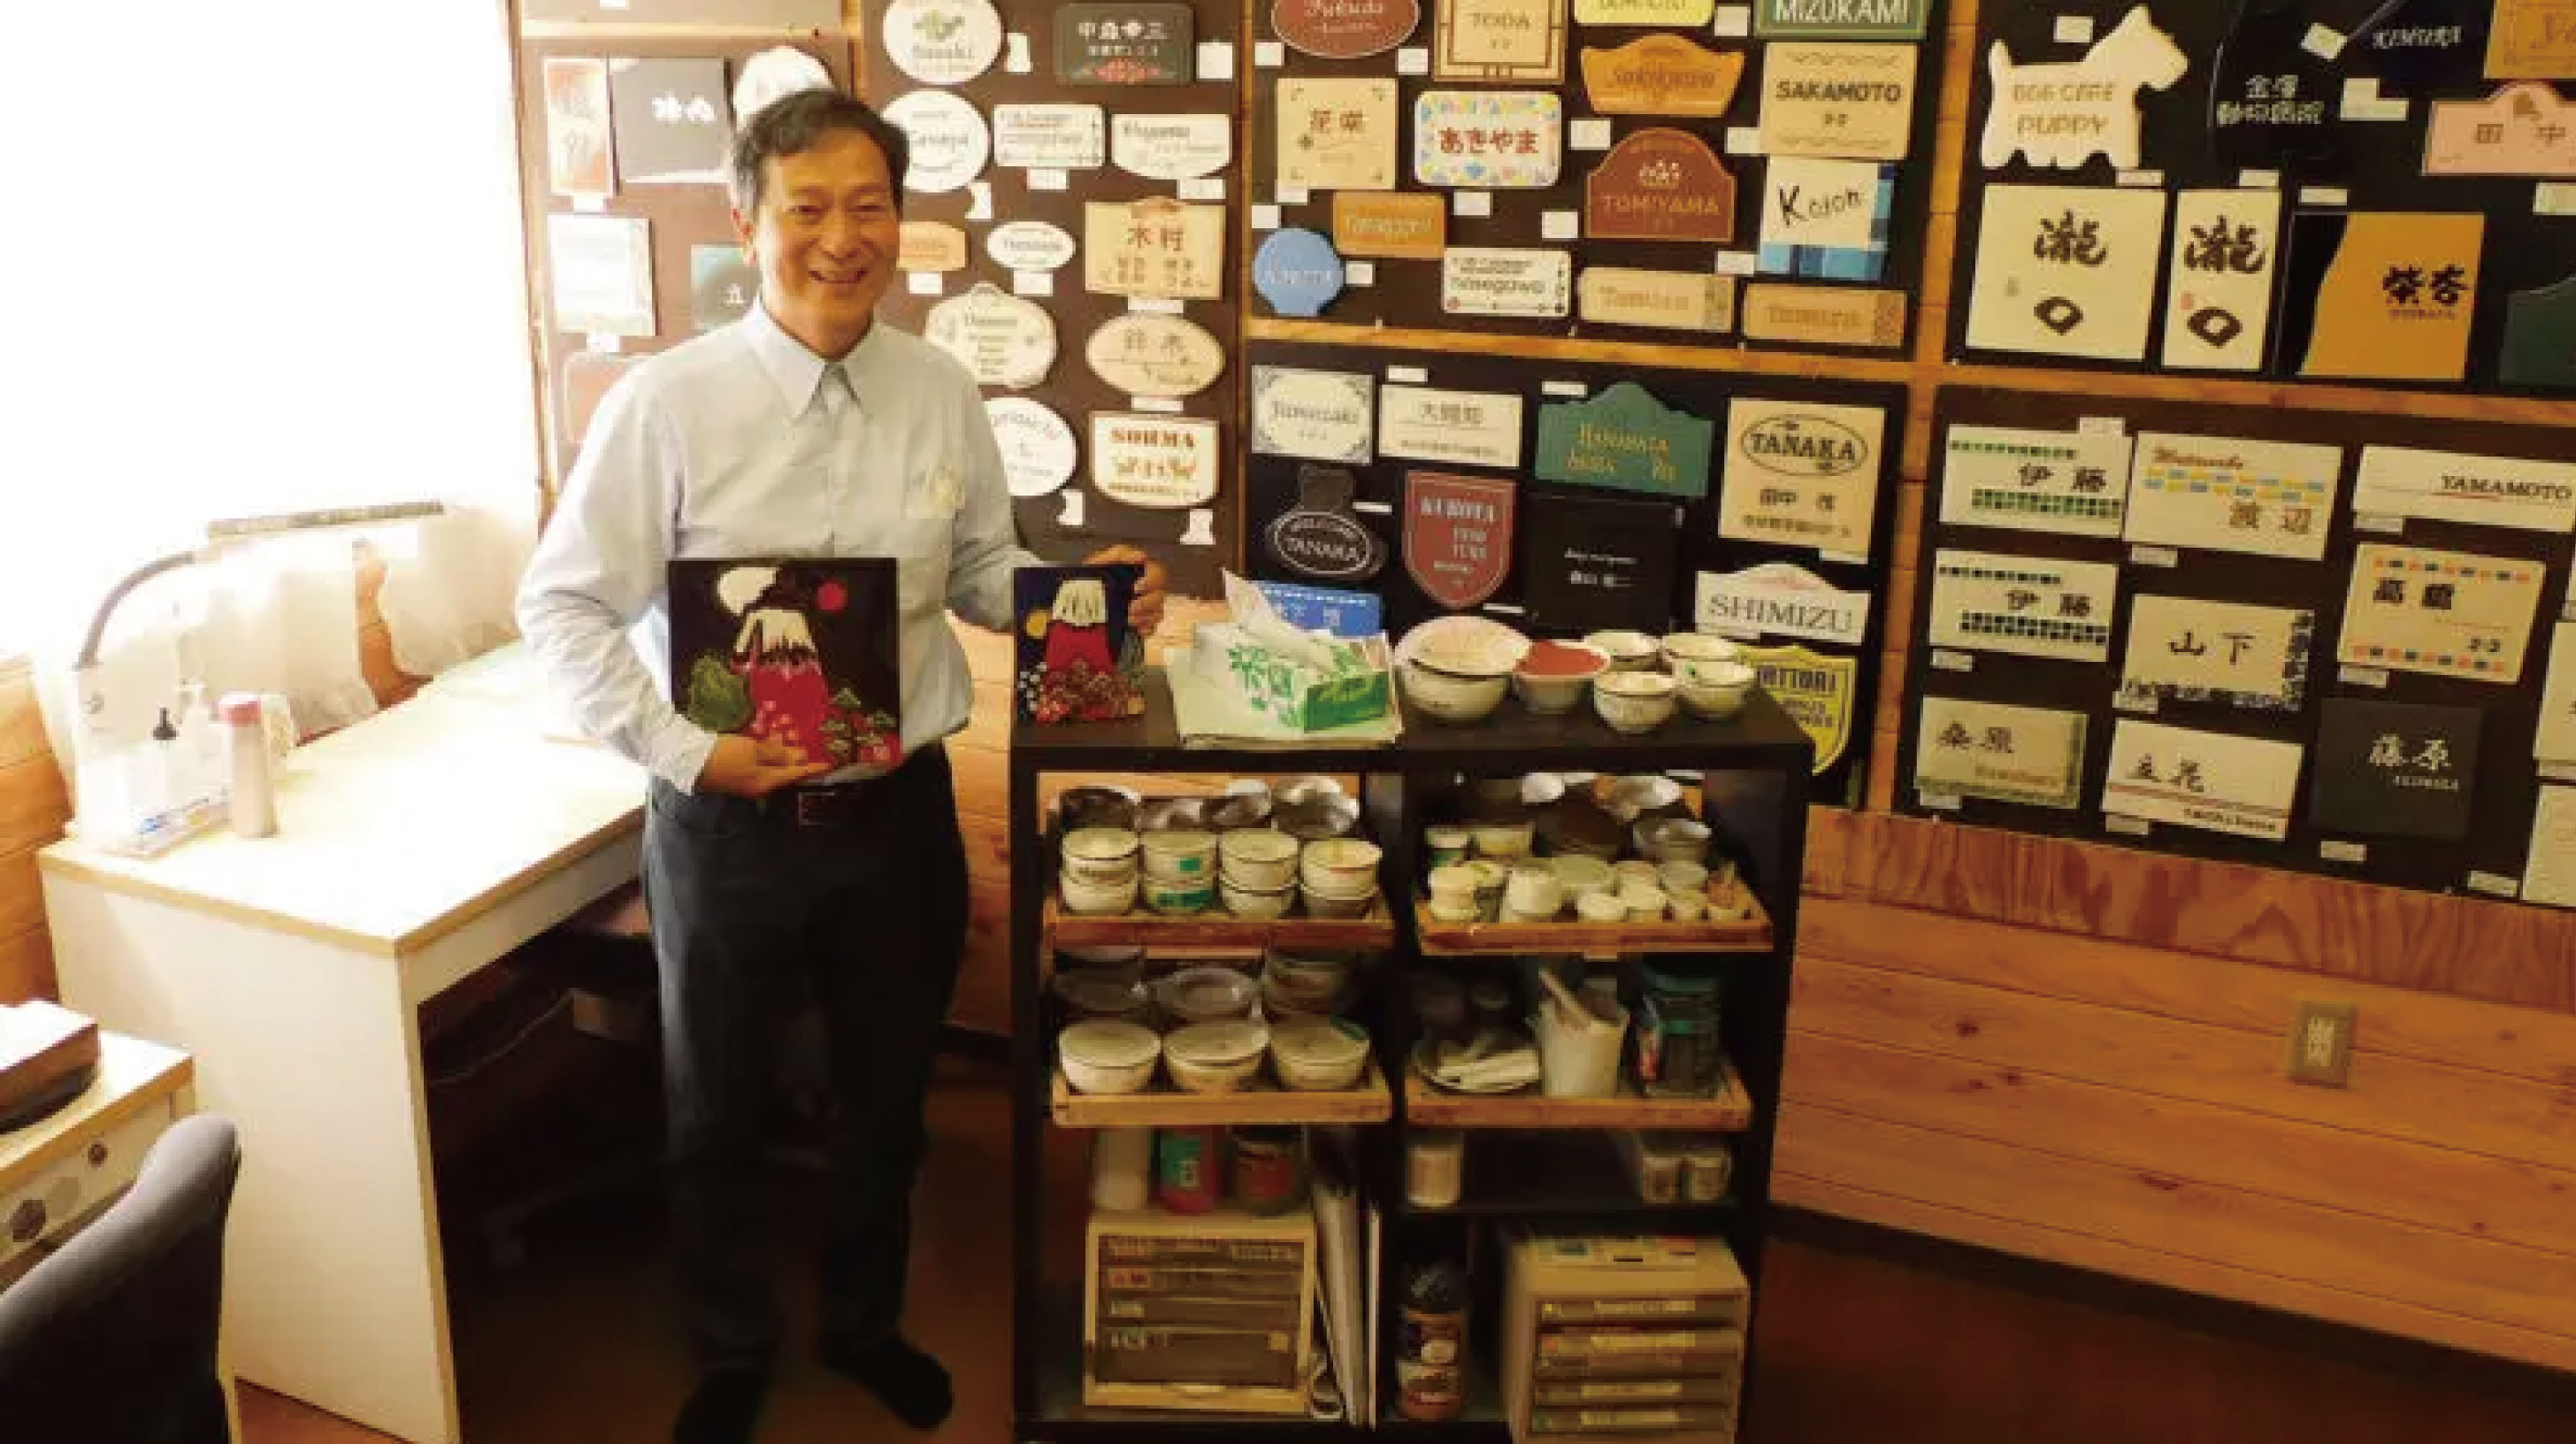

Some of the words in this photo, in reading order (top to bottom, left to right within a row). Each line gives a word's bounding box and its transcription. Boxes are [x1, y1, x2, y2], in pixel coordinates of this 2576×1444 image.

[1775, 81, 1902, 103] SAKAMOTO
[2017, 113, 2110, 135] PUPPY
[2473, 123, 2566, 145] 田中
[1438, 127, 1539, 154] あきやま
[1600, 194, 1721, 214] TOMIYAMA
[1126, 225, 1184, 252] 木村
[1750, 432, 1856, 462] TANAKA
[2440, 473, 2572, 503] YAMAMOTO
[1285, 536, 1360, 562] TANAKA
[1709, 593, 1853, 634] SHIMIZU
[2166, 629, 2257, 667] 山下
[1755, 664, 1837, 694] ATTORI
